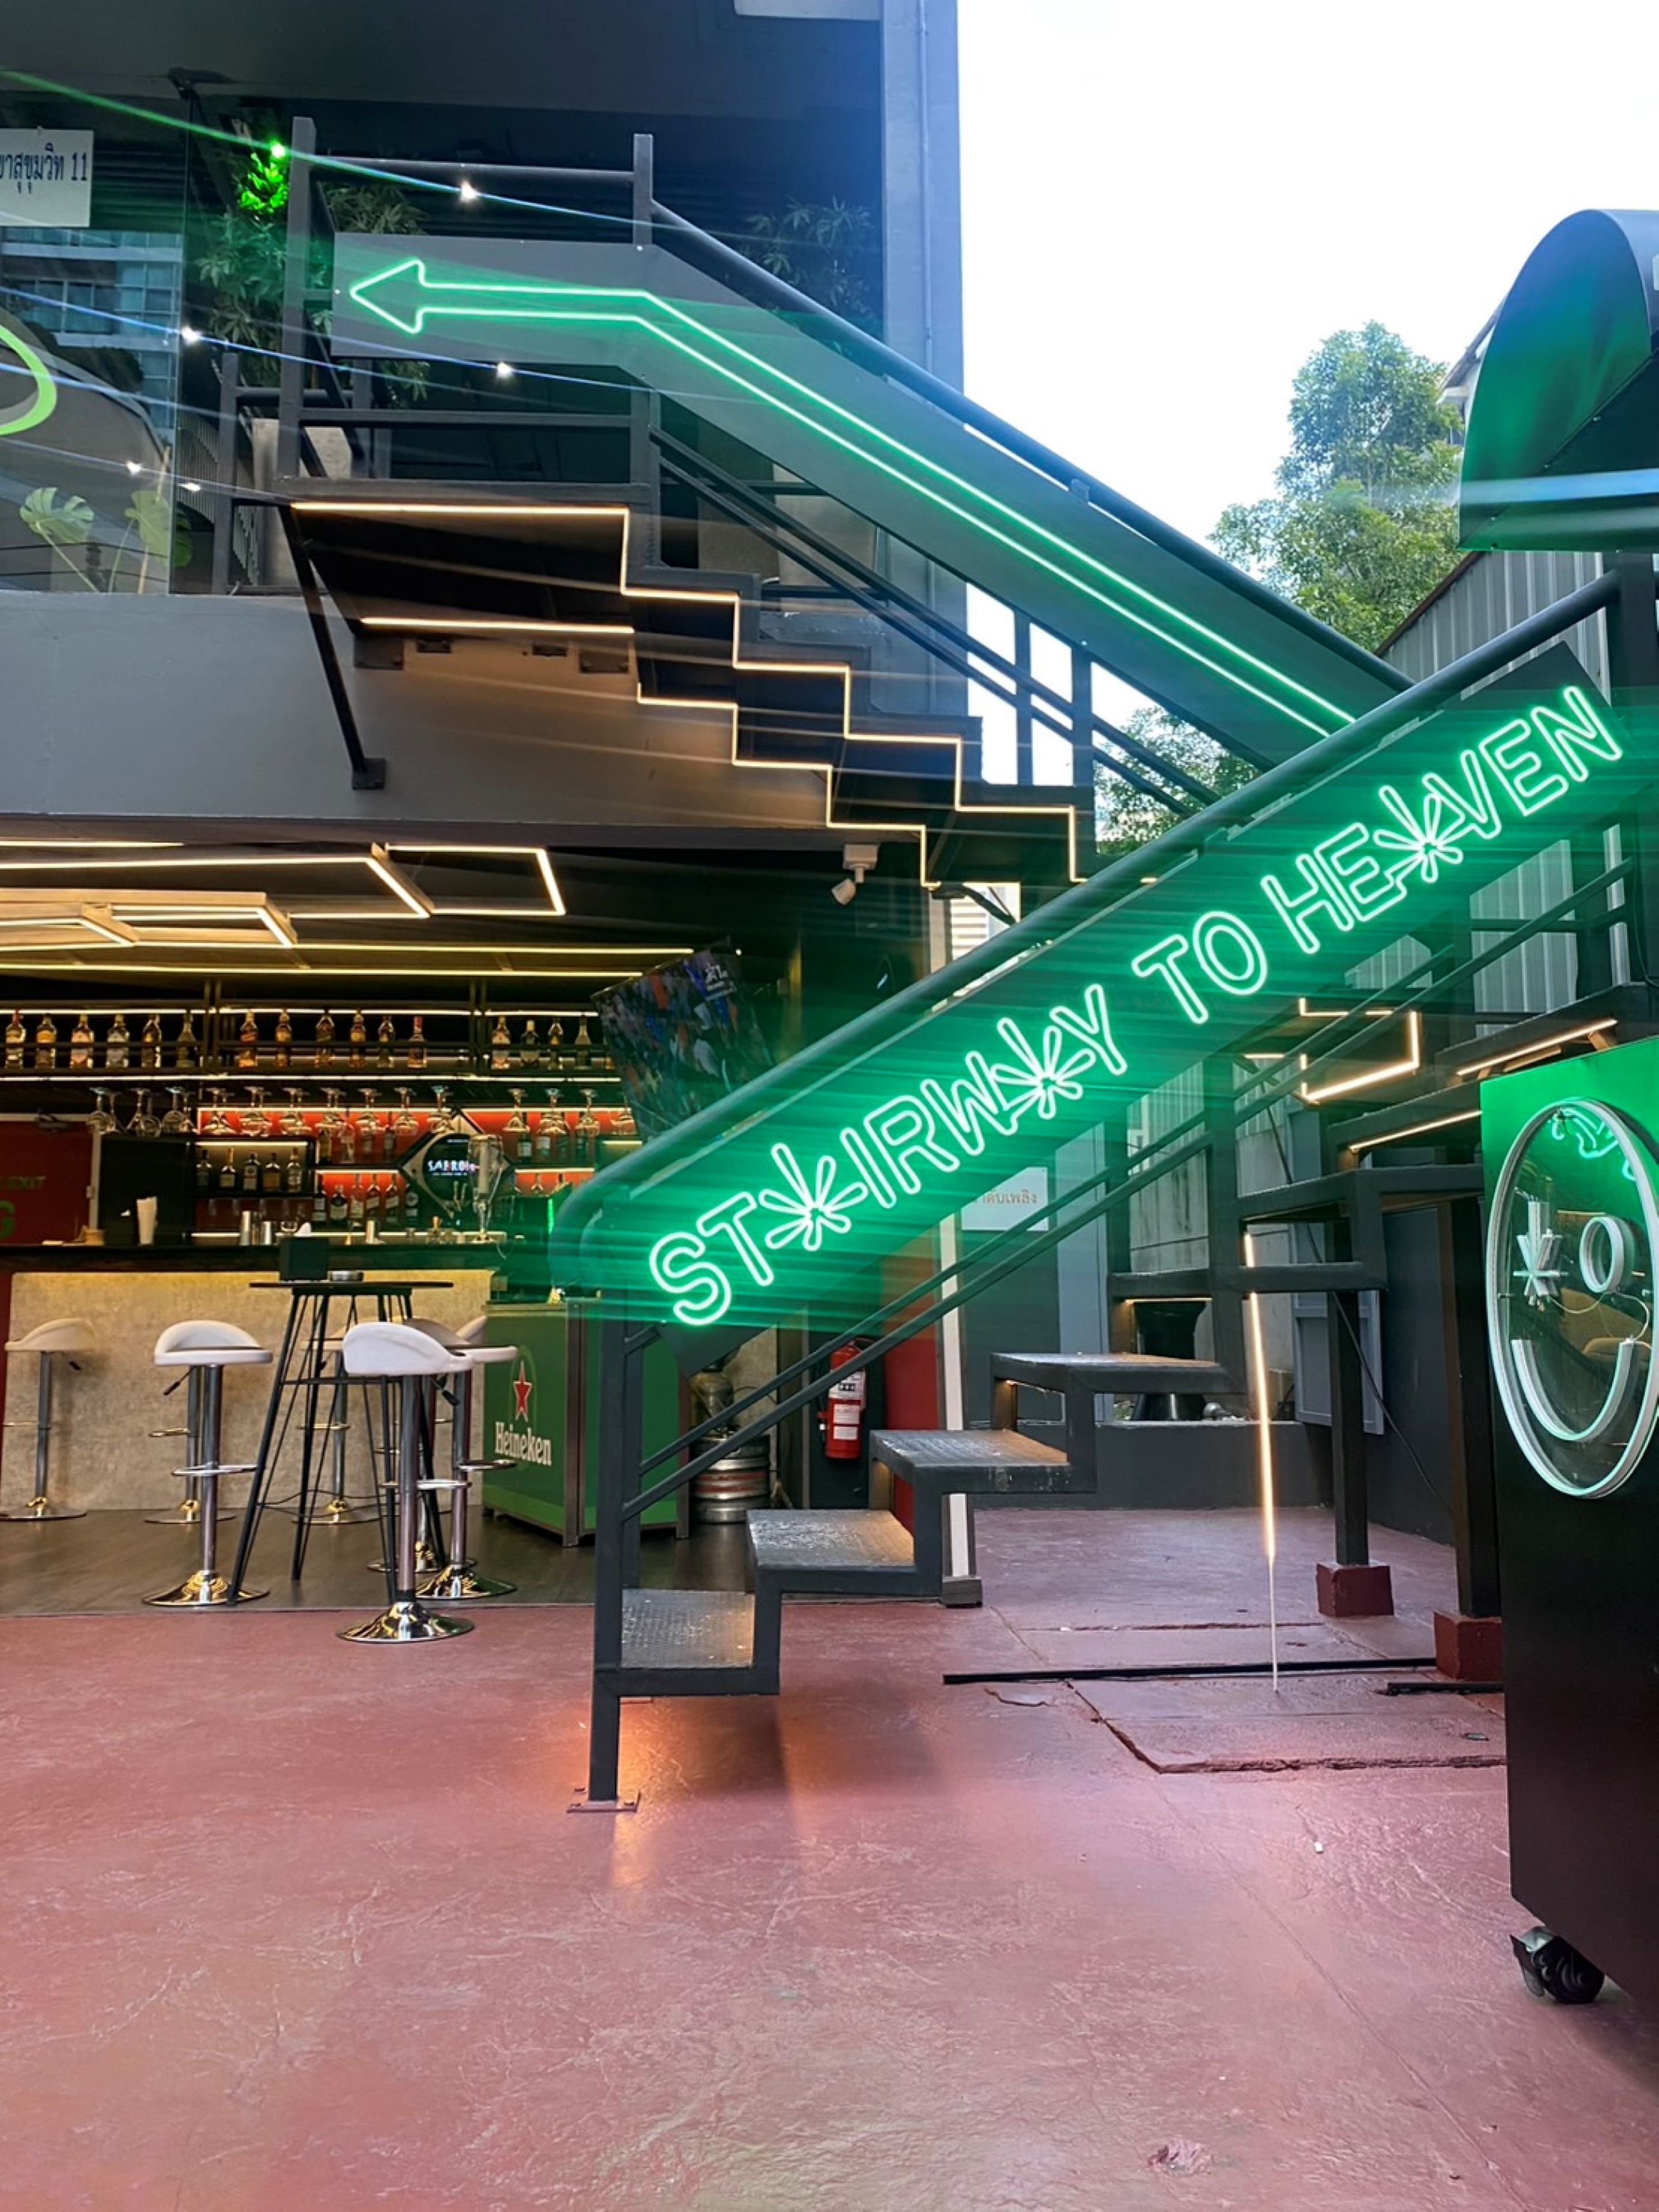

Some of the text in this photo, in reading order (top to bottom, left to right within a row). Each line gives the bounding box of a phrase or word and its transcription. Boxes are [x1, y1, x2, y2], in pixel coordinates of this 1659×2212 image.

[71, 152, 88, 181] 11
[1131, 909, 1268, 1026] TO
[495, 1421, 552, 1466] Heineken
